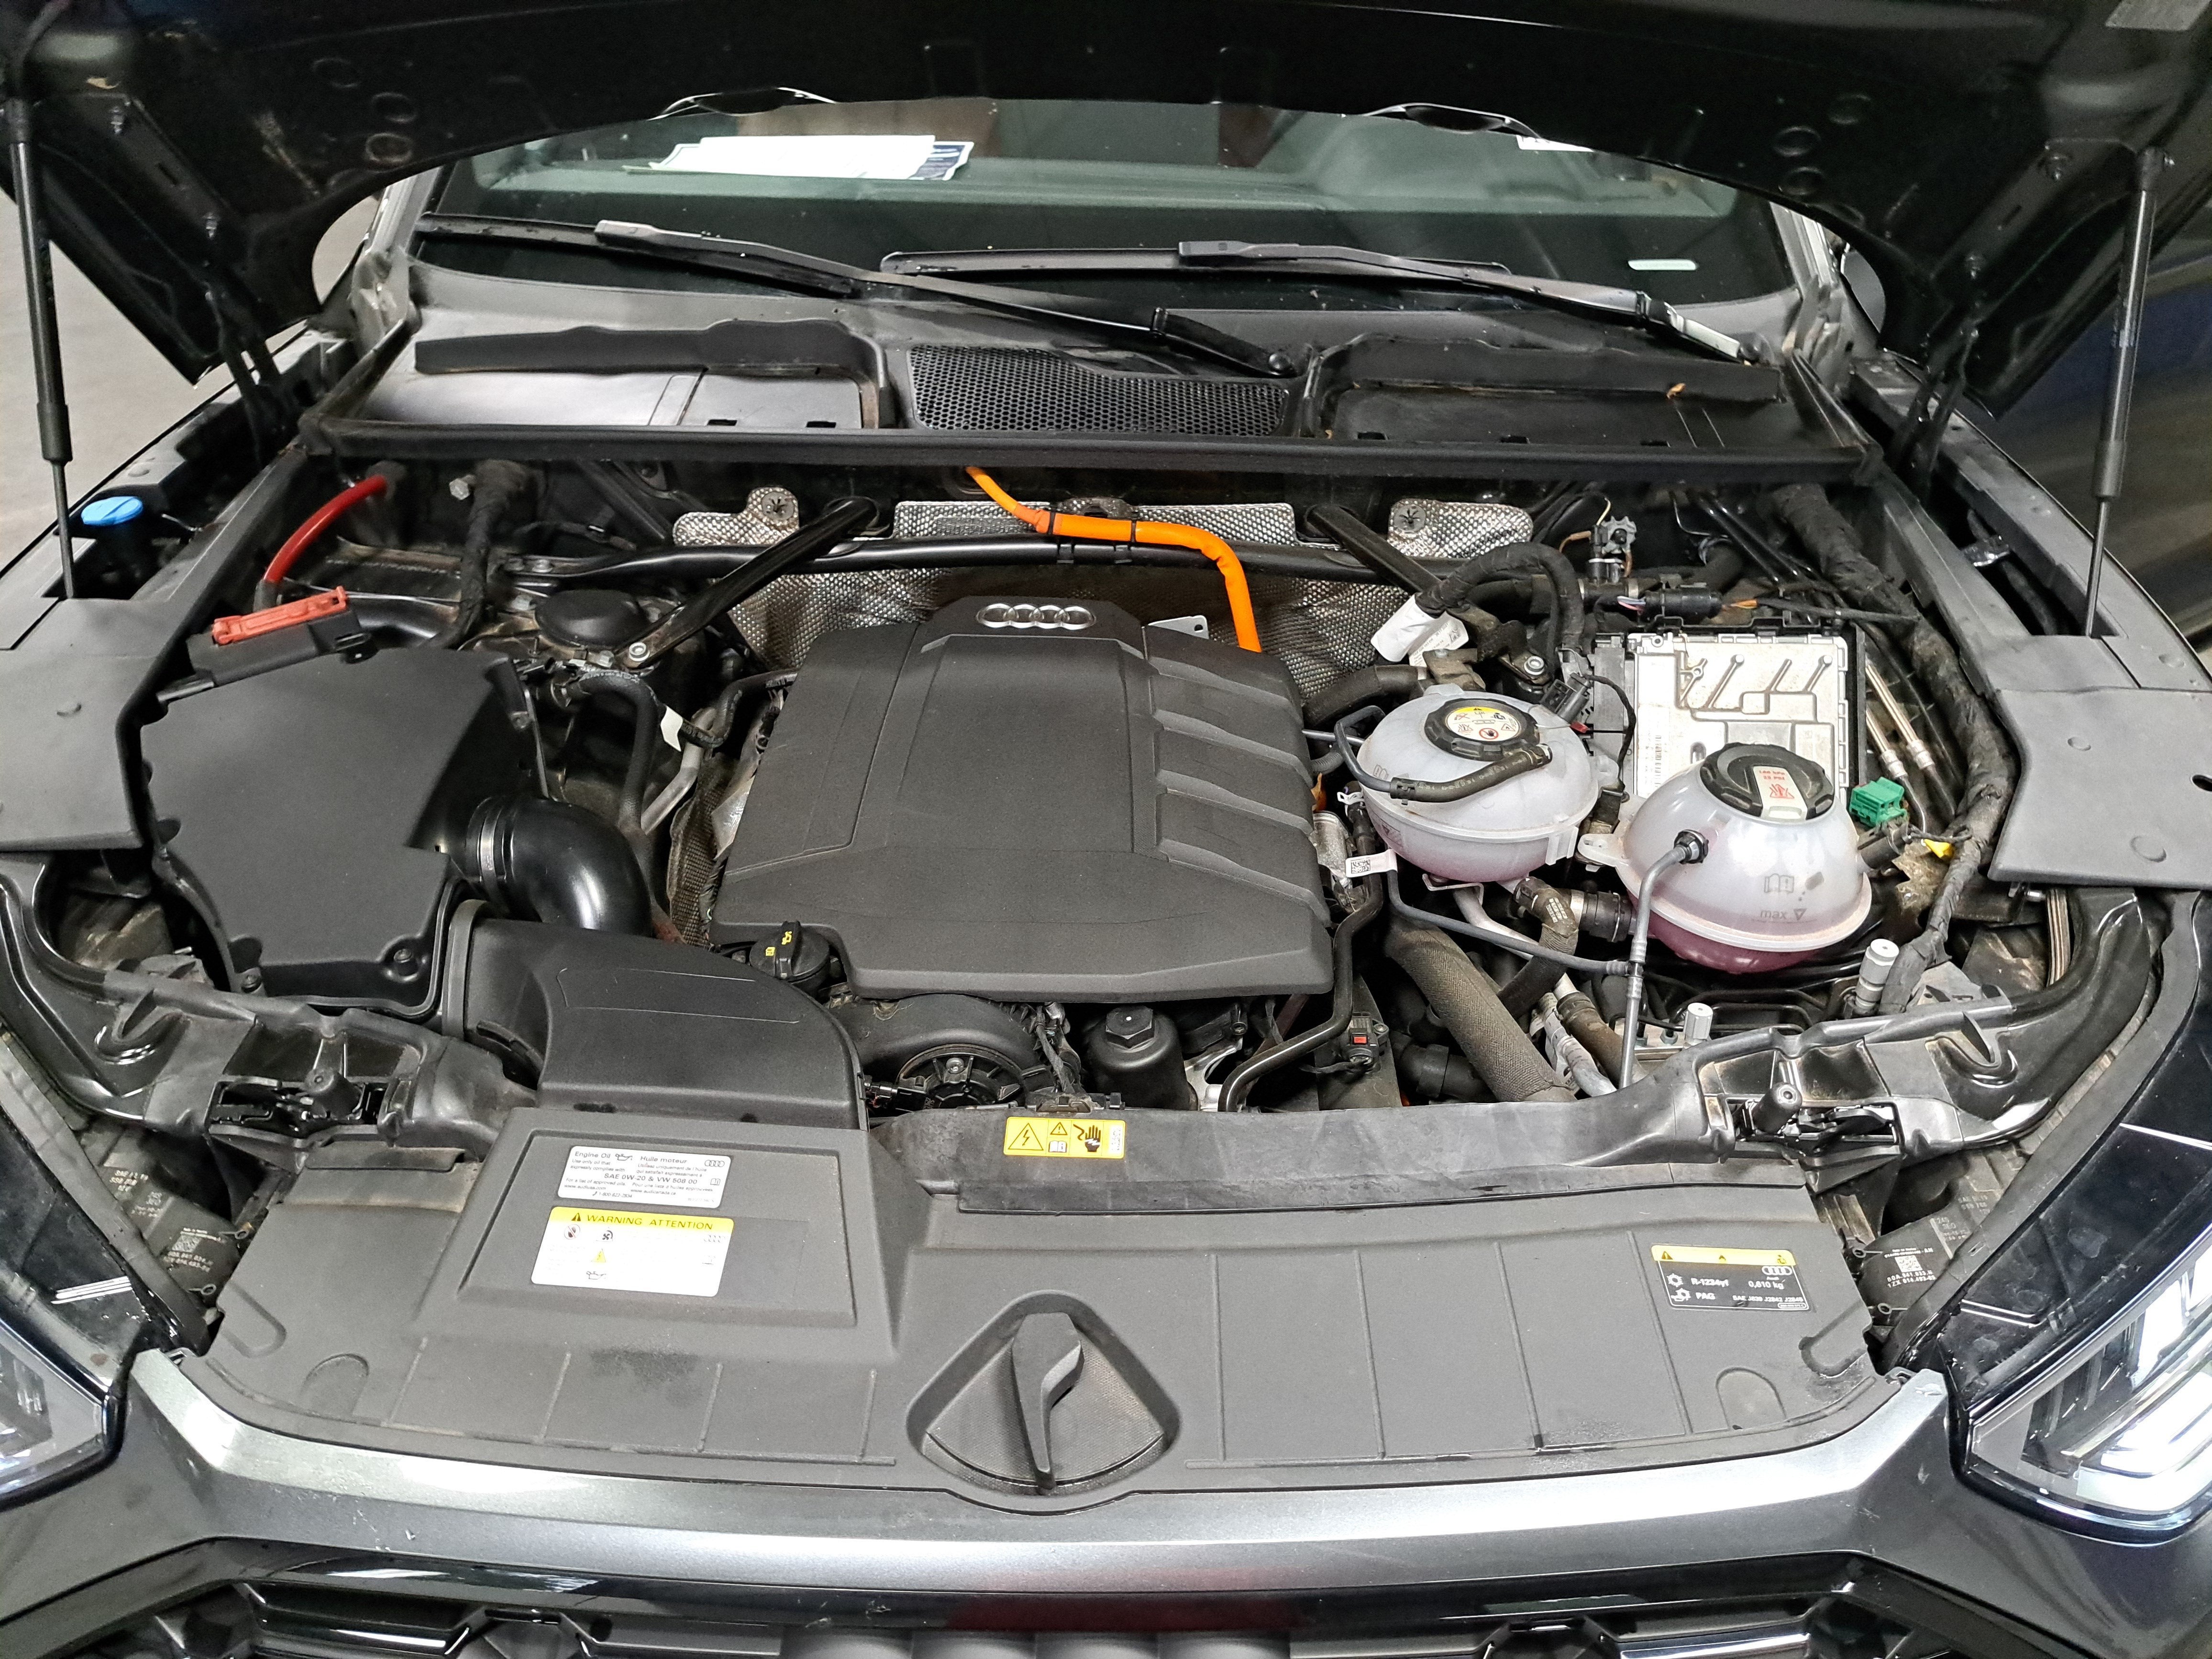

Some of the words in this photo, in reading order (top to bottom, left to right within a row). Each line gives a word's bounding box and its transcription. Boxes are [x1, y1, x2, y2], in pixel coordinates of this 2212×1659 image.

[1760, 910, 1787, 919] max
[586, 1215, 642, 1225] WARNING
[649, 1219, 713, 1230] ATTENTION
[1772, 1281, 1784, 1290] kg
